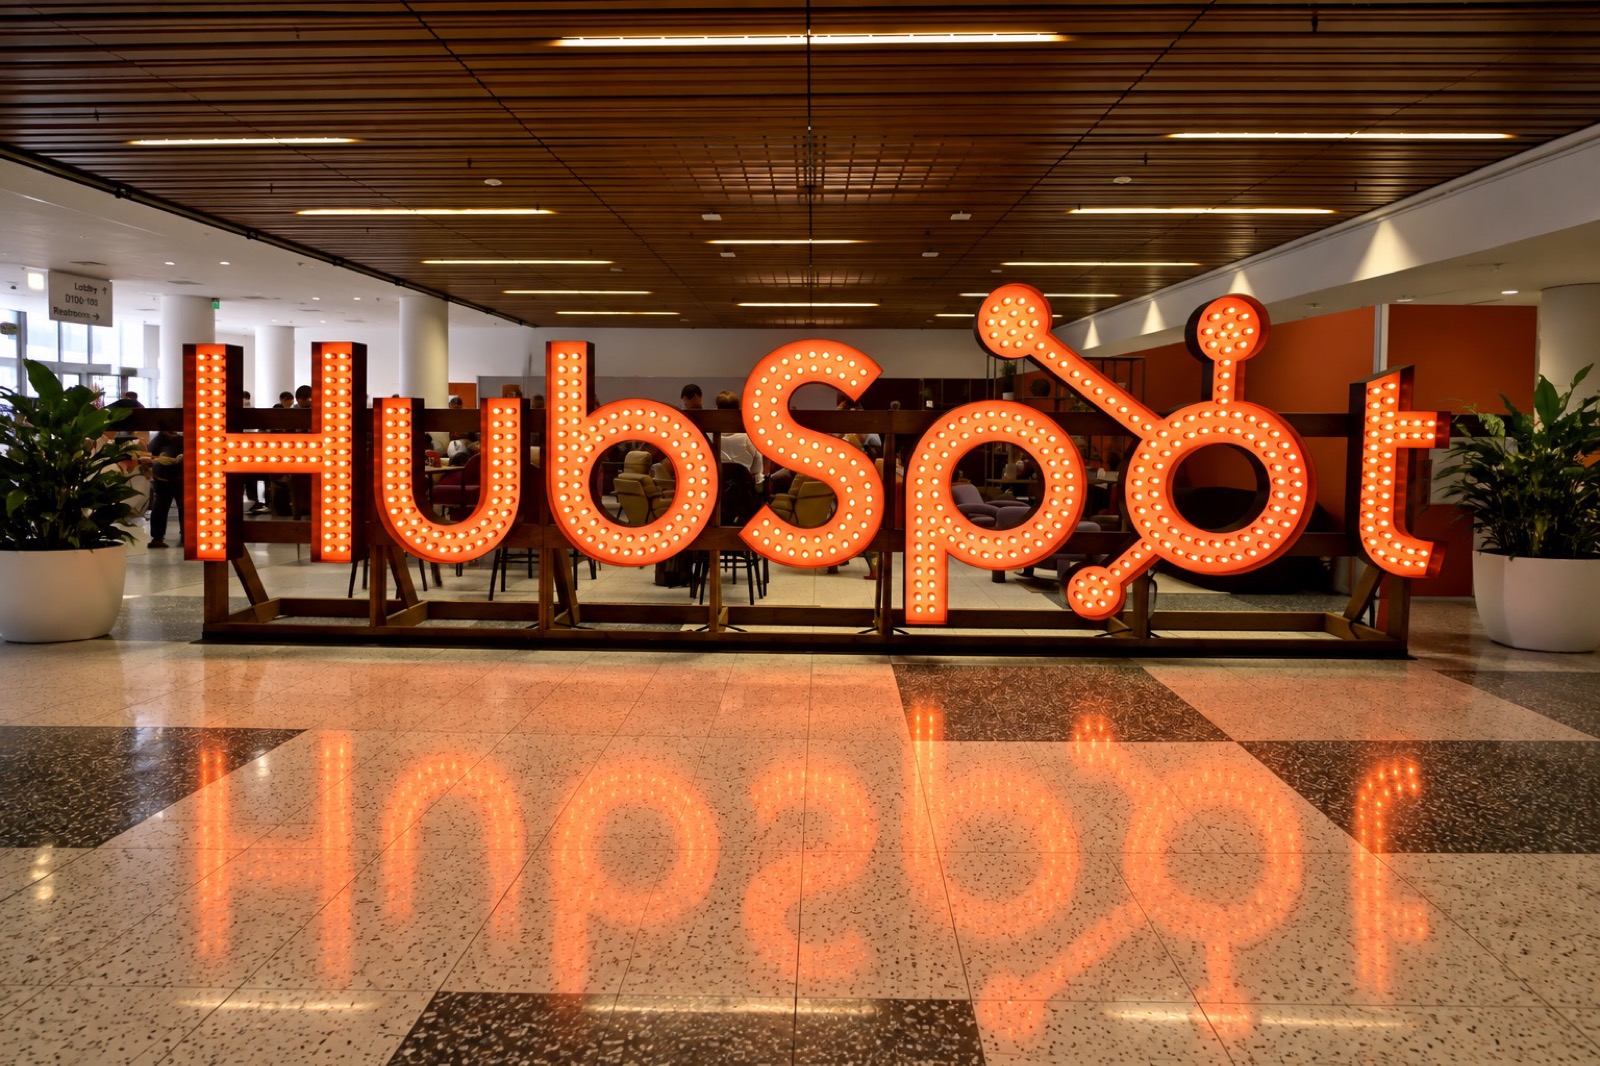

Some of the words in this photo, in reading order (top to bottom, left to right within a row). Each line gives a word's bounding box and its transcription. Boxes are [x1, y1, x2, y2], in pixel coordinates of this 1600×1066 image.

[74, 282, 98, 294] Lobby
[53, 306, 91, 319] Restrooms
[183, 283, 1450, 624] HubSpot
